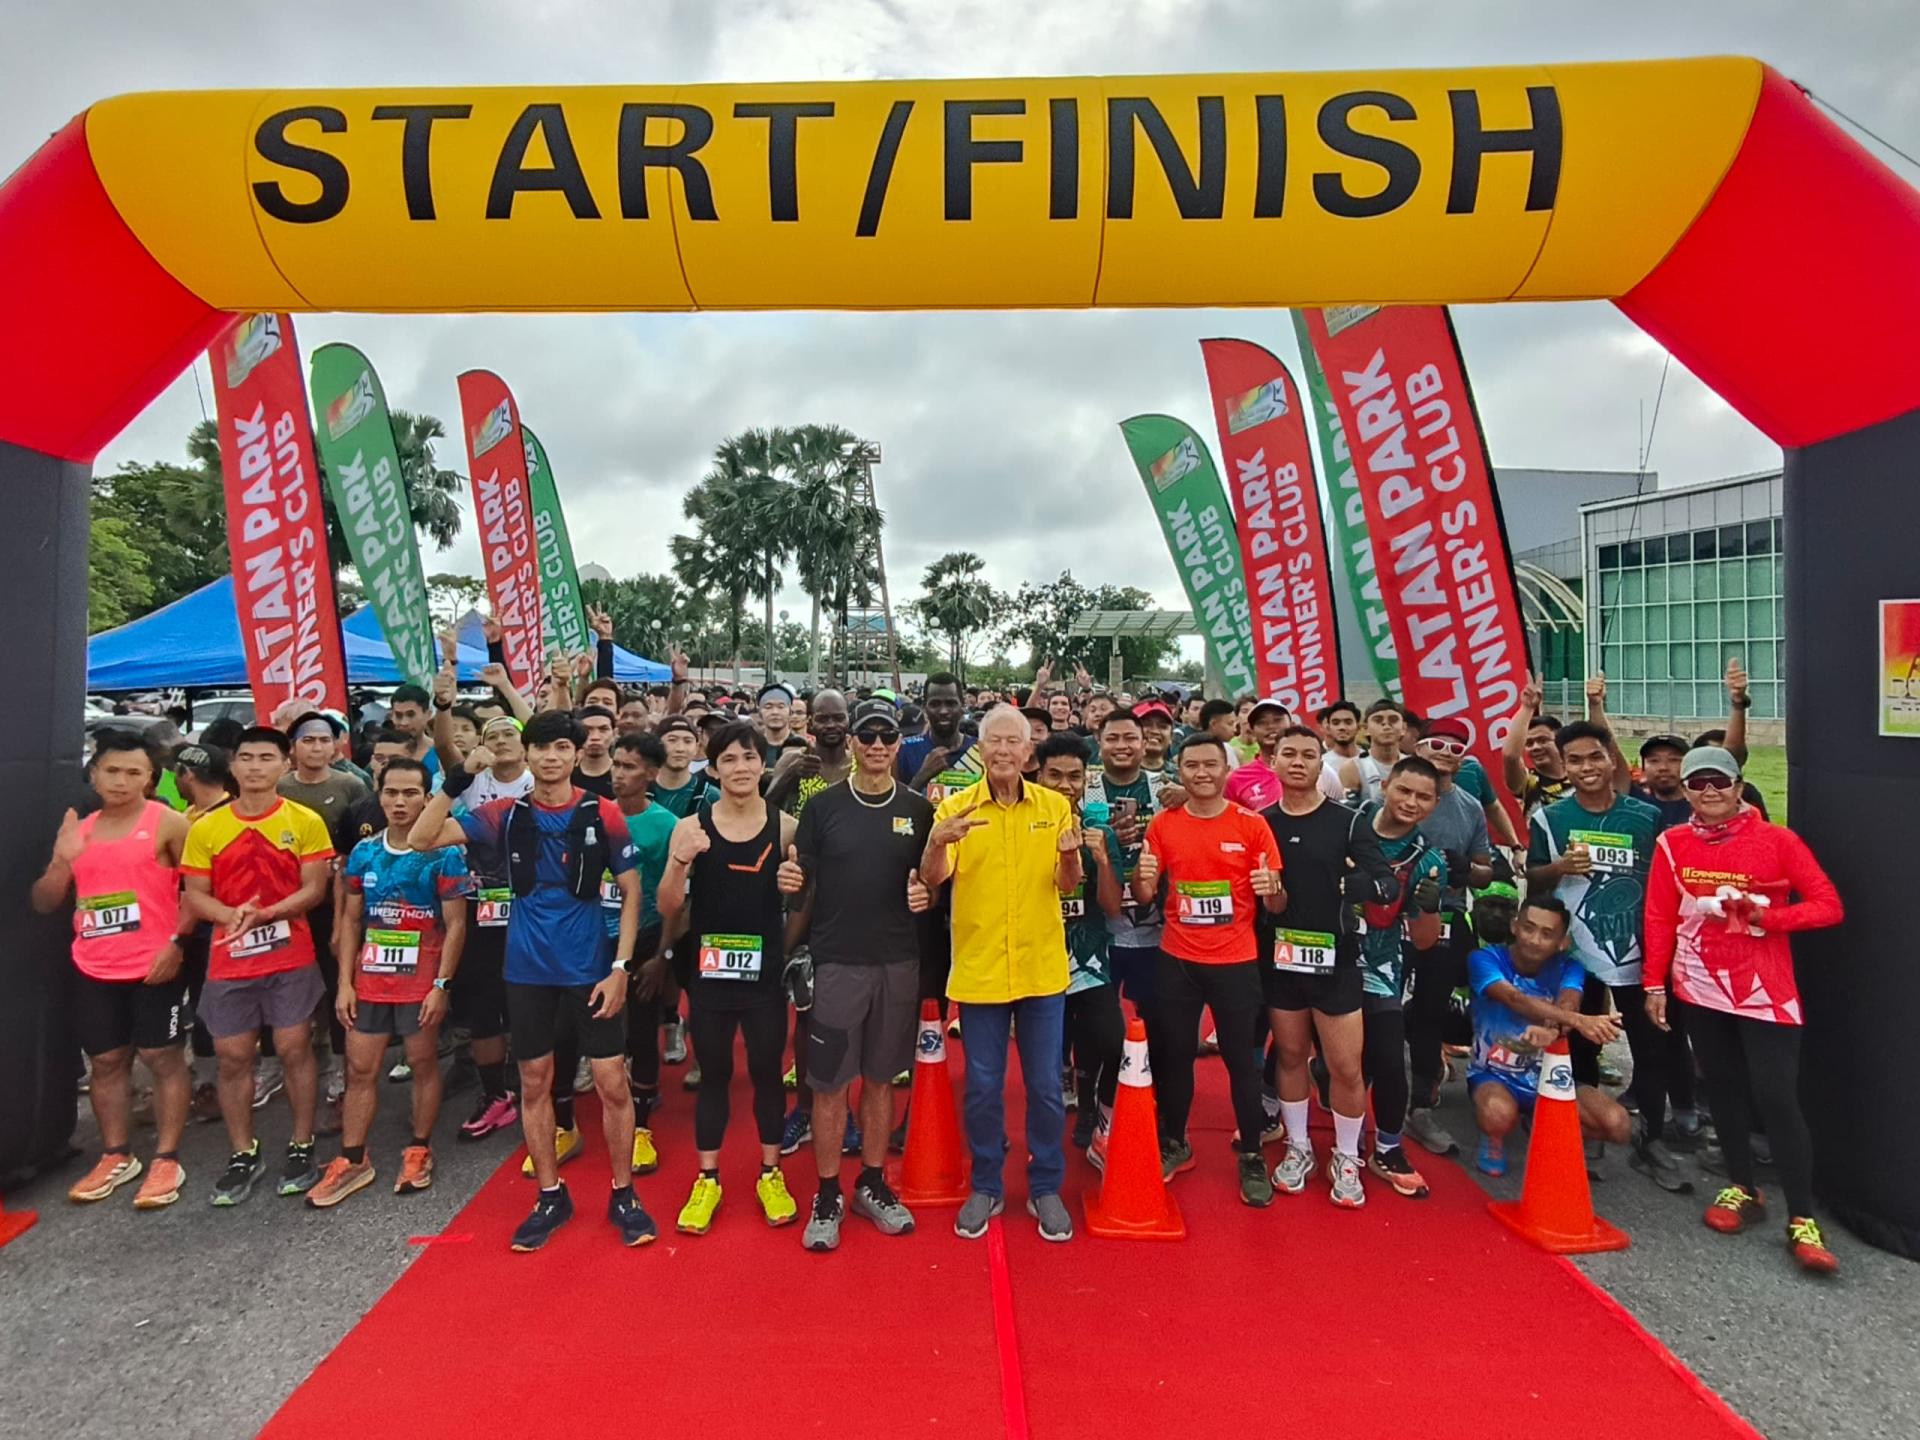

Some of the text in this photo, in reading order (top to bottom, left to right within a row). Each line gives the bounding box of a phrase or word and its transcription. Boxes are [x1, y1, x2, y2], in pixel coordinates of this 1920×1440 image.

[252, 86, 1562, 237] START/FINISH
[1342, 347, 1424, 519] PARK
[1406, 363, 1466, 492] CLUB
[234, 400, 280, 543] PARK
[338, 449, 385, 567] PARK
[372, 456, 405, 546] CLUB
[1237, 448, 1279, 558] PARK
[478, 468, 512, 572] PARK
[505, 477, 529, 558] CLUB
[534, 510, 563, 578] CLUB
[1166, 498, 1214, 591] PARK
[1199, 505, 1234, 576] CLUB
[273, 411, 326, 705] UNNER'S CLUB
[1275, 462, 1328, 713] RUNNER'S CLUB
[931, 787, 941, 800] A
[1596, 847, 1627, 864] 093
[81, 907, 128, 928] A 077
[252, 926, 278, 944] 112
[479, 905, 491, 918] A
[1062, 902, 1080, 915] 94
[1180, 898, 1222, 914] A 119
[363, 948, 405, 963] A 111
[703, 951, 754, 968] A 012
[1277, 945, 1324, 964] A 118
